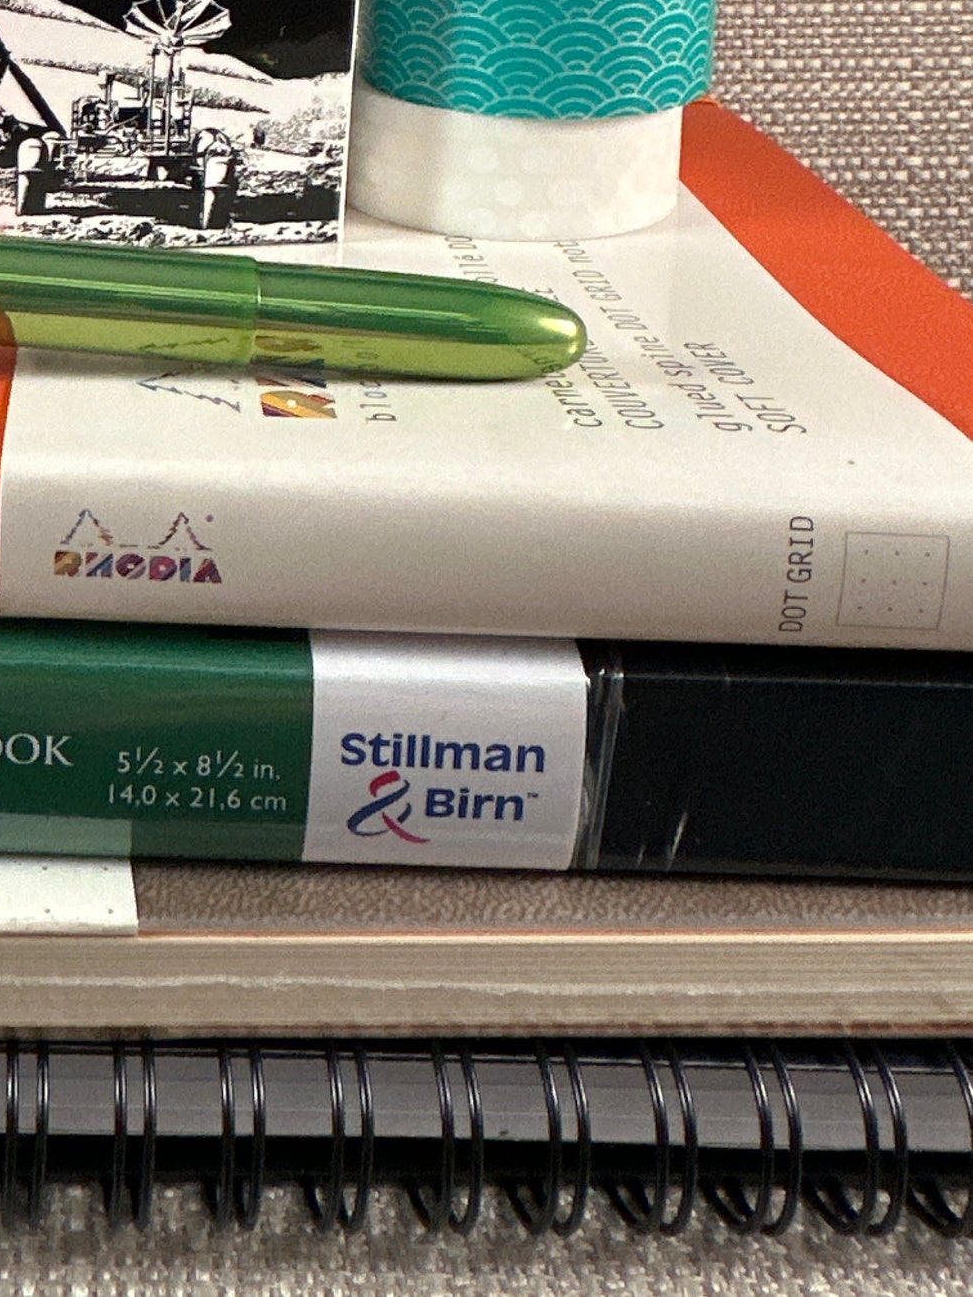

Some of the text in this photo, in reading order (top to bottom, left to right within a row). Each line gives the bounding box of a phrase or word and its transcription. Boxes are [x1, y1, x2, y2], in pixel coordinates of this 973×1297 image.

[572, 269, 623, 302] GRID
[599, 305, 649, 331] DOT
[633, 335, 697, 379] spine
[668, 382, 754, 433] glued
[683, 341, 807, 434] SOFT COVER
[778, 515, 814, 633] DOT GRID
[172, 761, 188, 776] x
[341, 732, 546, 773] Stillman
[165, 792, 181, 808] x
[249, 795, 288, 812] cm
